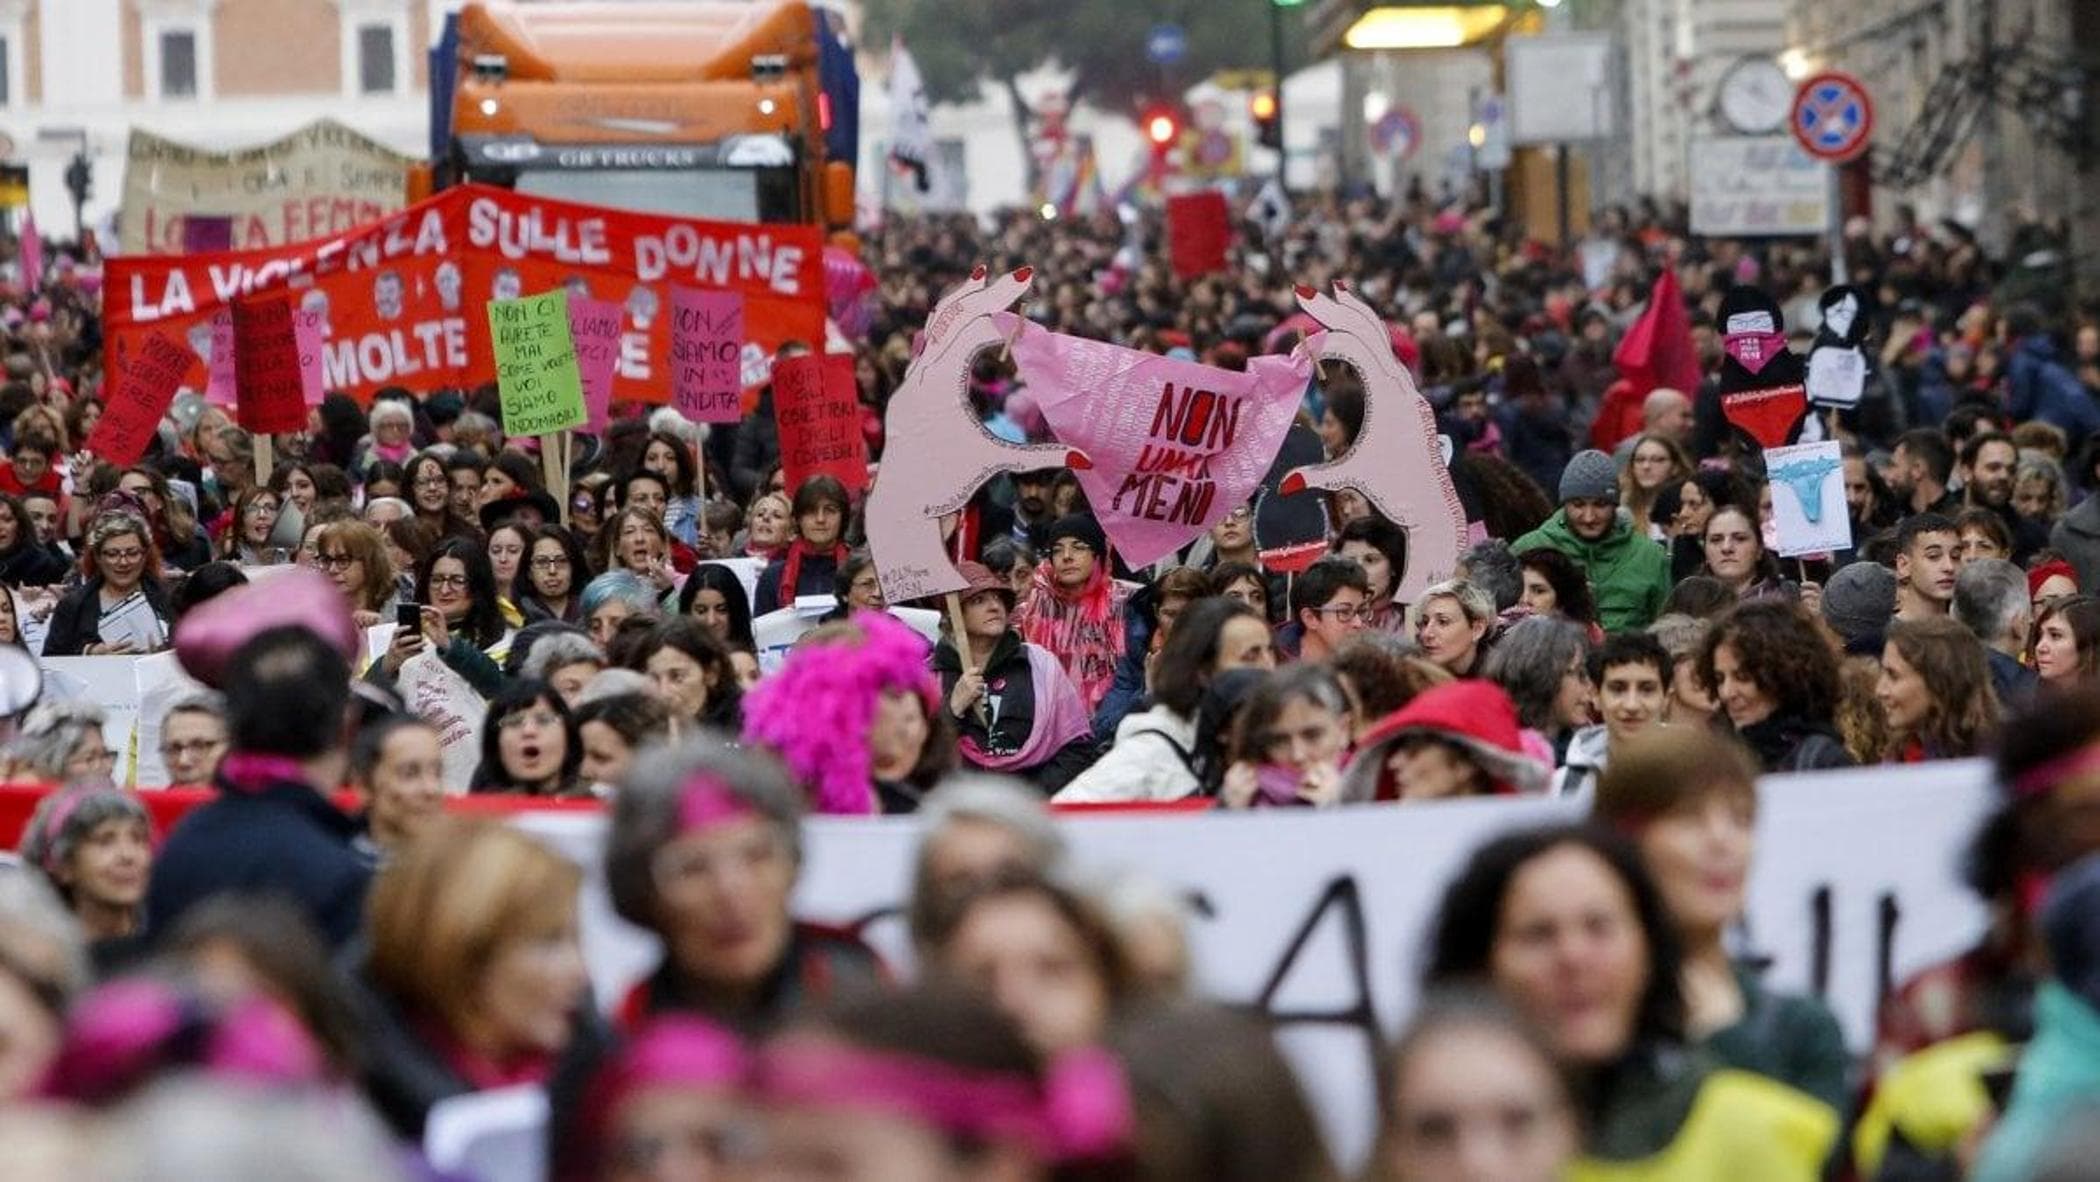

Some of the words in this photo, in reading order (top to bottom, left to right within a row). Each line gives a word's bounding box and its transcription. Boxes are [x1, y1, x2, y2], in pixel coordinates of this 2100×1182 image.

[600, 151, 694, 167] TRUCKS
[130, 269, 196, 321] LA
[469, 198, 611, 265] SULLE
[634, 224, 803, 295] DONNE
[495, 304, 527, 322] NON
[537, 300, 555, 317] CI
[322, 319, 468, 390] MOLTE
[515, 345, 543, 360] MAI
[683, 367, 705, 385] IN
[506, 391, 557, 416] SIAMO
[1151, 382, 1242, 450] NON
